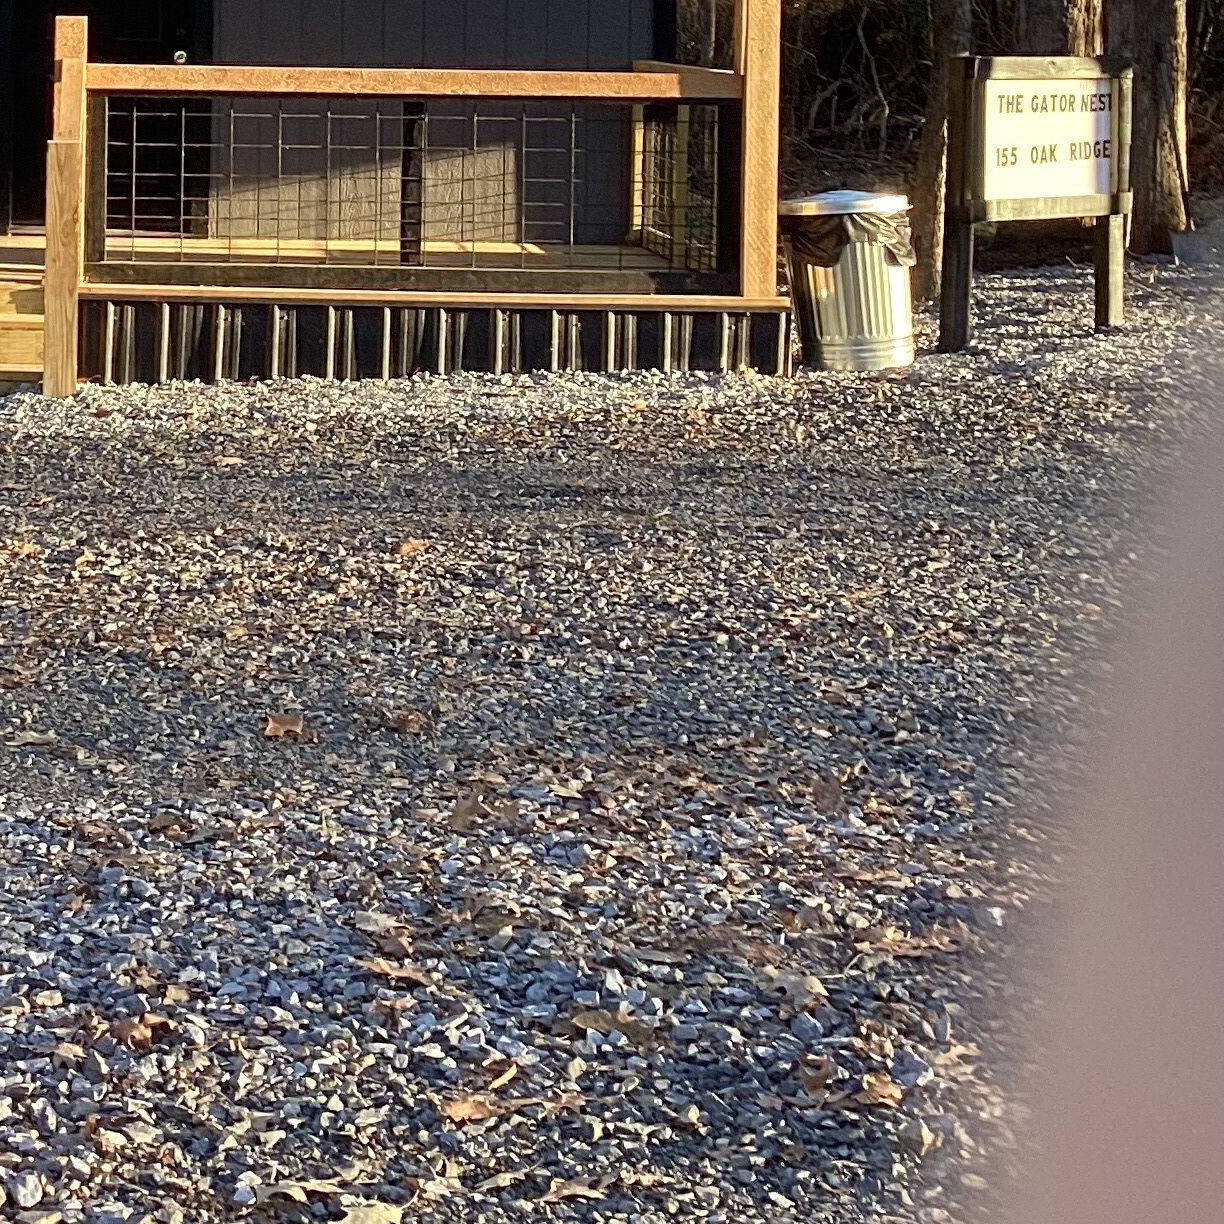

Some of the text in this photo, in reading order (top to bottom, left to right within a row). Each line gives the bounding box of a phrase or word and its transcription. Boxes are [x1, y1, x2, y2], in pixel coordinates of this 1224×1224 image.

[998, 93, 1113, 113] THE GATOR NEST
[996, 140, 1111, 166] 155 OAK RIDGE
